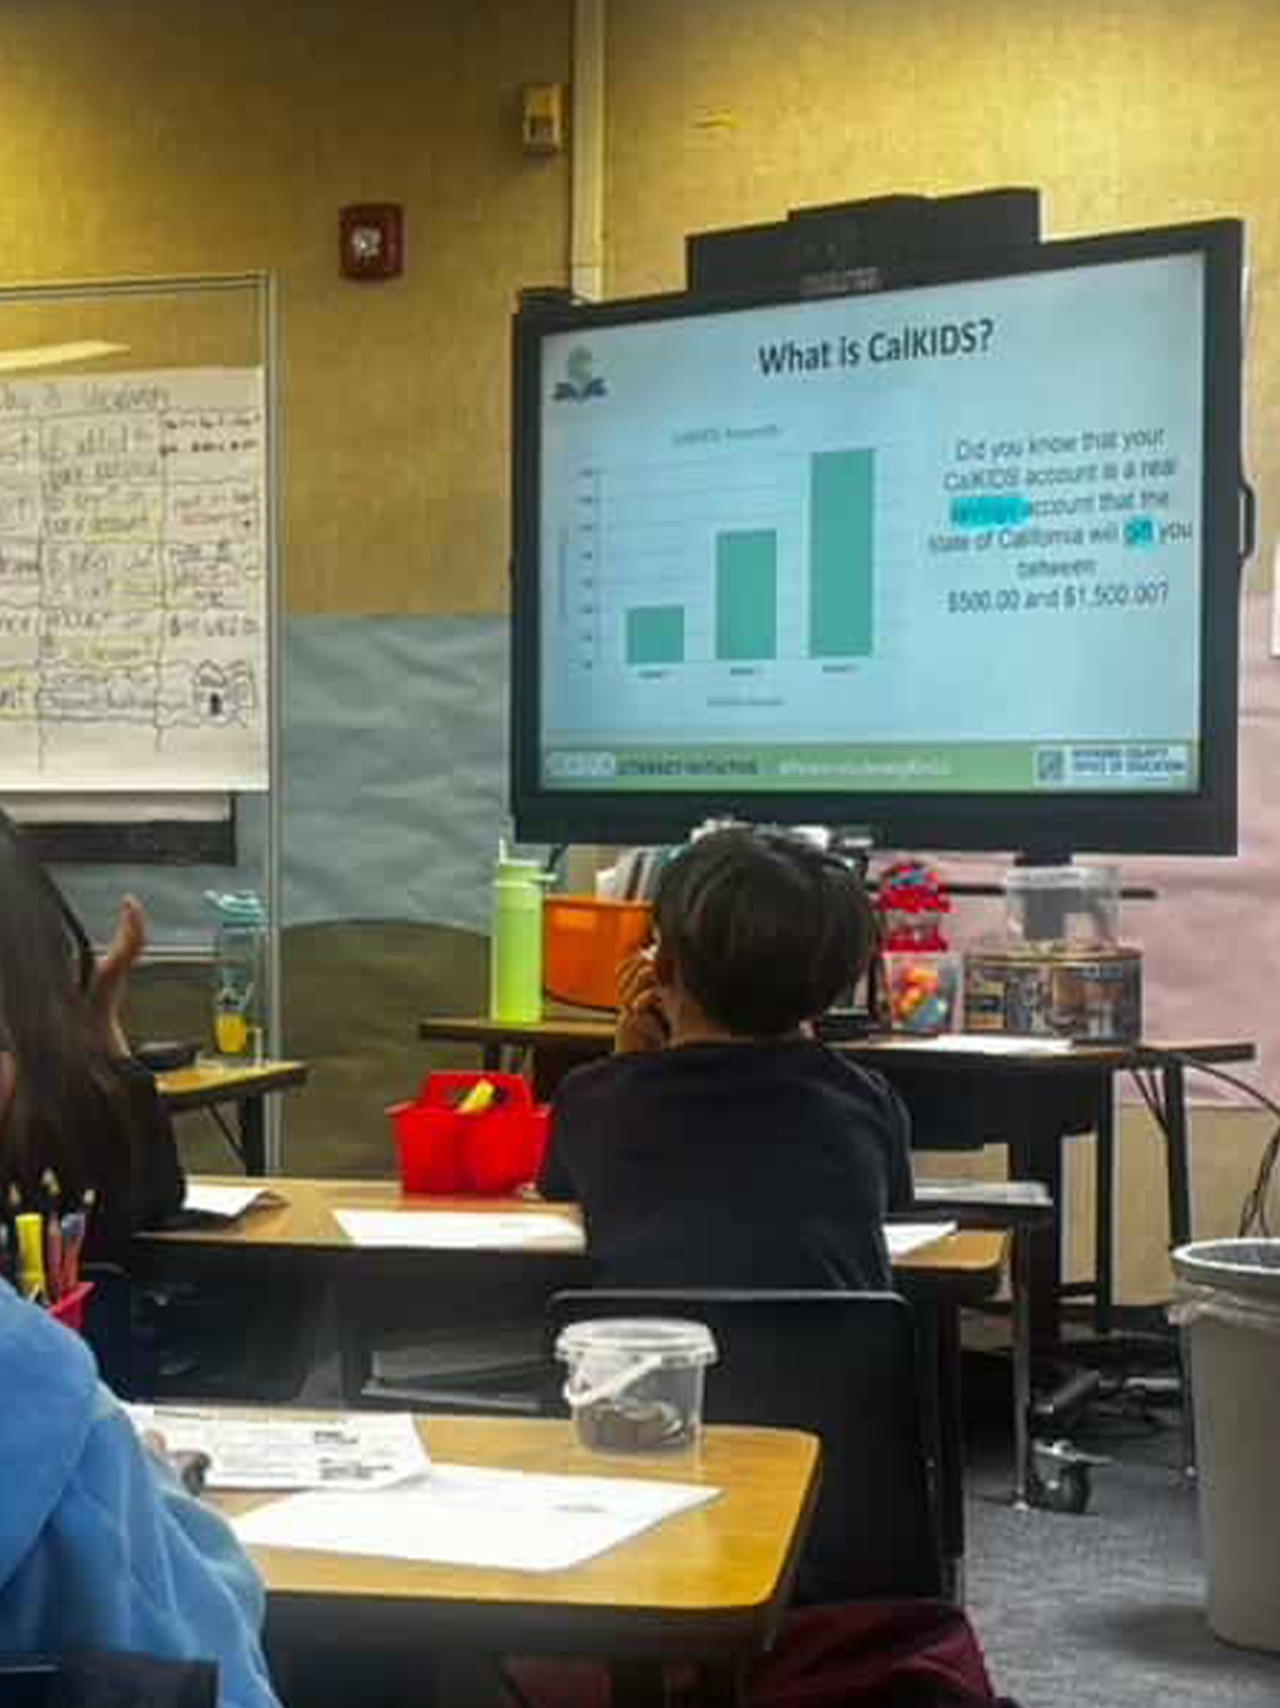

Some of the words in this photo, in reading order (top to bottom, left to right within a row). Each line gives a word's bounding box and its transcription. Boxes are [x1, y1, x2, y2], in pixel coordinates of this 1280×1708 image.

[758, 342, 830, 376] What
[838, 335, 861, 368] is
[867, 317, 994, 364] CalKIDS?
[956, 440, 986, 461] Did
[990, 442, 1021, 461] you
[1028, 437, 1077, 454] know
[1081, 431, 1117, 451] that
[1121, 427, 1165, 452] your
[1025, 464, 1099, 485] account
[1159, 520, 1194, 544] you
[1023, 588, 1060, 611] and
